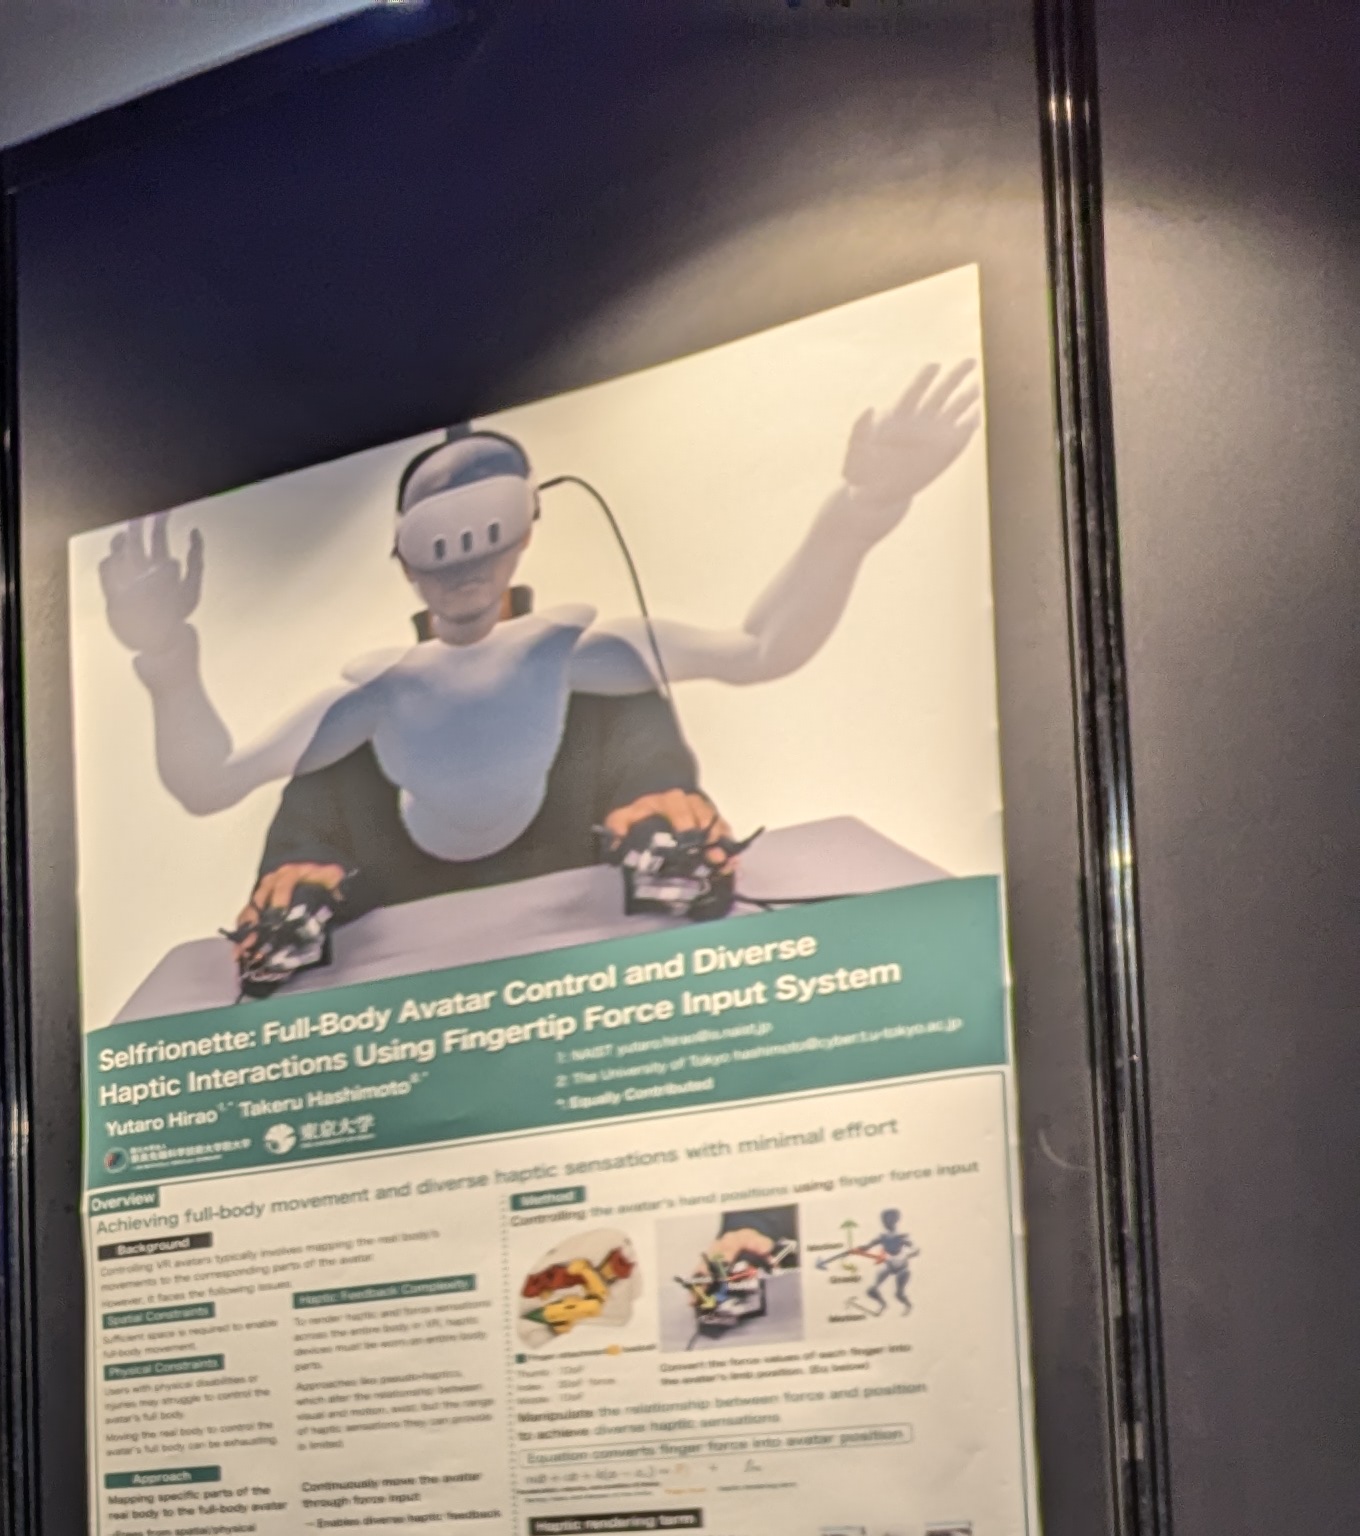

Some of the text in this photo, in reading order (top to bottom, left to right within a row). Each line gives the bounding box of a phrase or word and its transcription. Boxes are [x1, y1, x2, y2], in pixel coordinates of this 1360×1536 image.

[98, 935, 818, 1072] Selfrionette: Full-Body Avatar Control and Diverse
[98, 962, 902, 1107] Haptic Interactions Using Fingertip Force Input System
